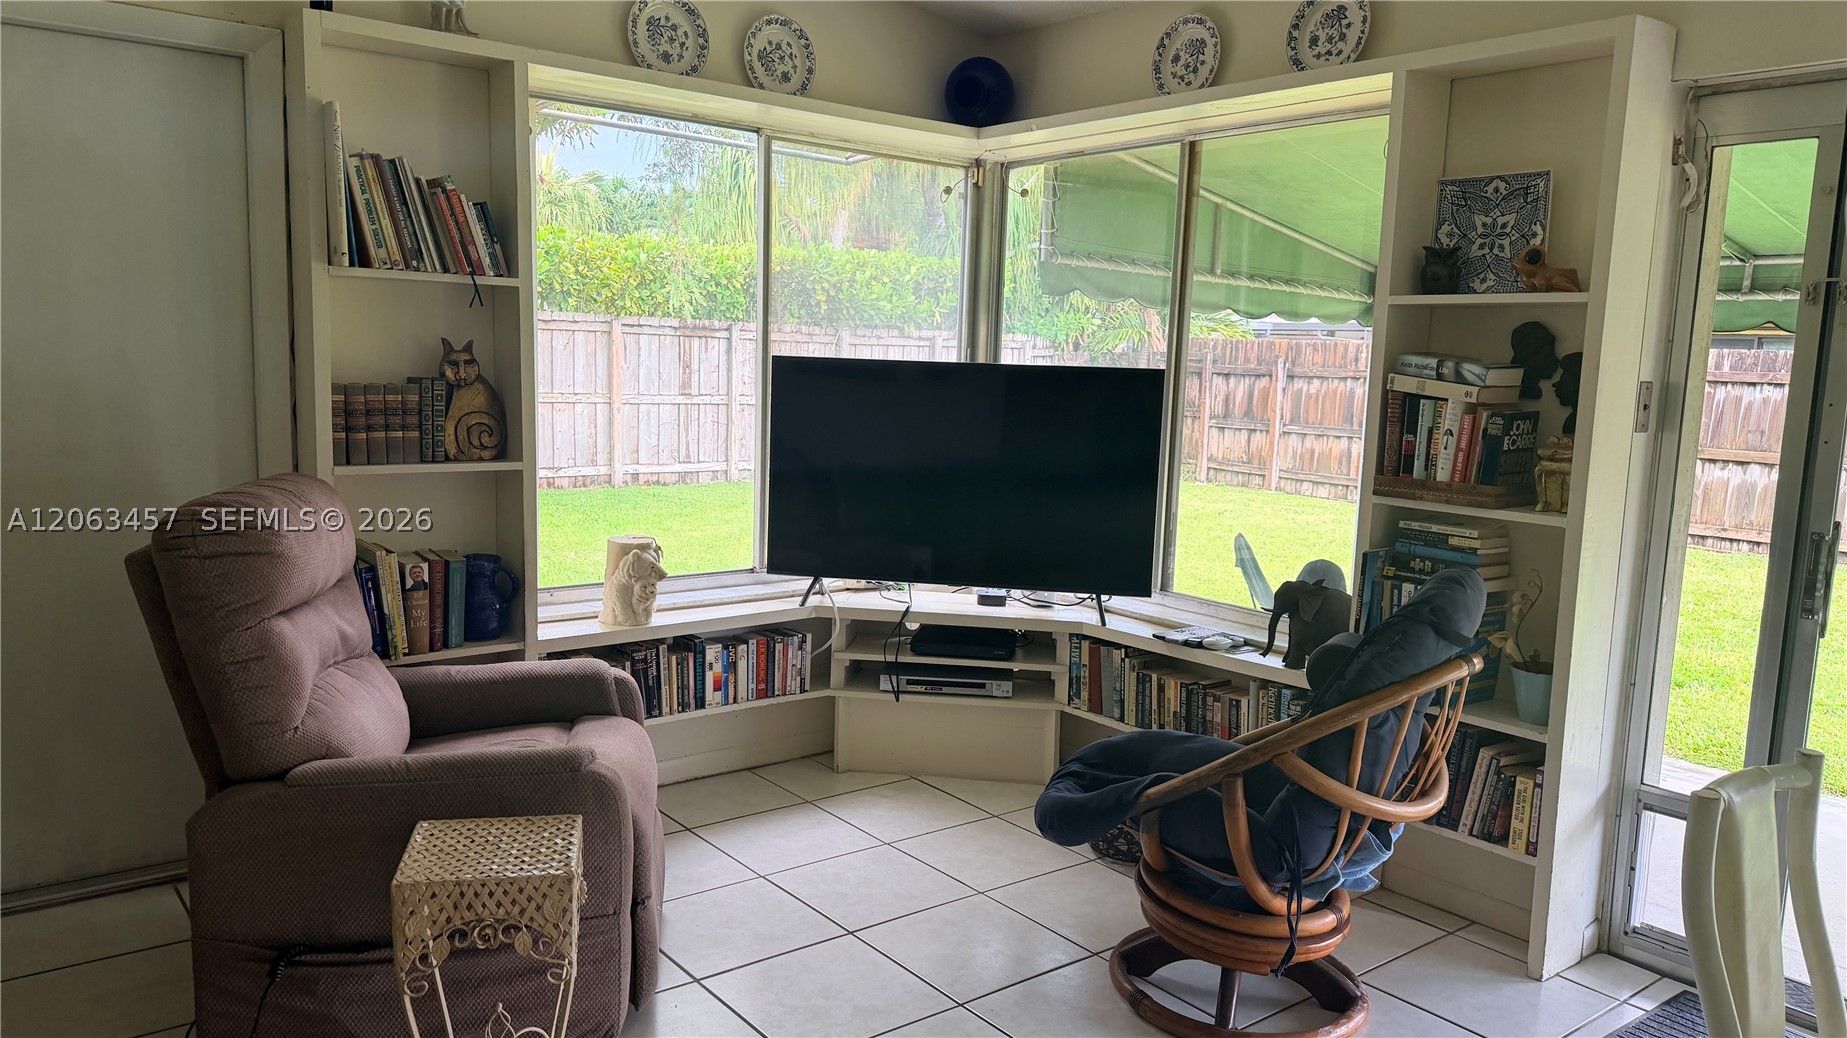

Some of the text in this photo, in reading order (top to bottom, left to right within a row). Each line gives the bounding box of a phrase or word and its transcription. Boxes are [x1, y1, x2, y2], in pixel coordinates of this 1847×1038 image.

[353, 164, 367, 197] PRACTICAL
[363, 198, 377, 226] PROBLEM
[371, 227, 384, 250] SOLVER
[450, 191, 465, 223] CARIBBEAN
[1413, 363, 1436, 372] Richards
[1438, 366, 1449, 374] Life
[1434, 410, 1443, 432] DEAD
[1510, 419, 1534, 435] JOHN
[411, 620, 428, 628] Life
[412, 609, 426, 620] My
[1071, 635, 1080, 663] ALIVE
[1267, 686, 1278, 725] Kenned
[1513, 788, 1523, 820] DRAGON TATTOO
[1509, 826, 1518, 845] LARSSON
